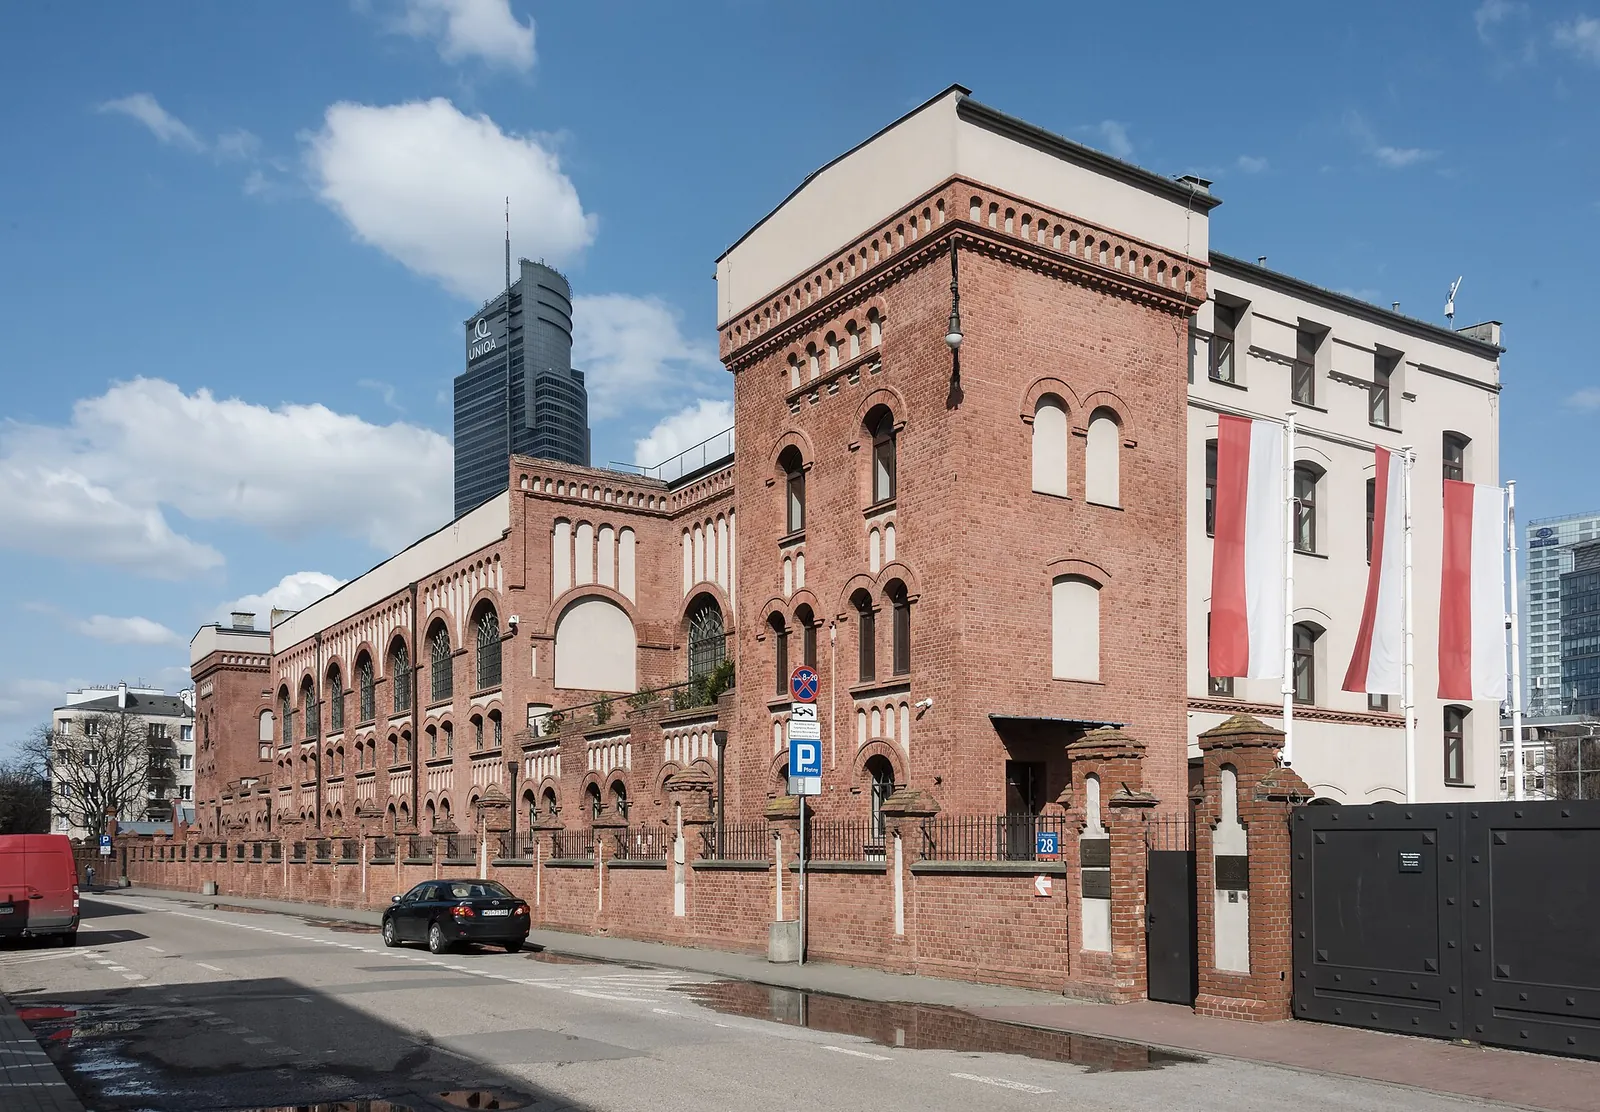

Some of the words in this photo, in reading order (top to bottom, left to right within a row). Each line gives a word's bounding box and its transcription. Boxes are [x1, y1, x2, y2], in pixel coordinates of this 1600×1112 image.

[469, 338, 496, 360] UNIQA
[797, 744, 815, 772] P
[1041, 839, 1053, 852] 28
